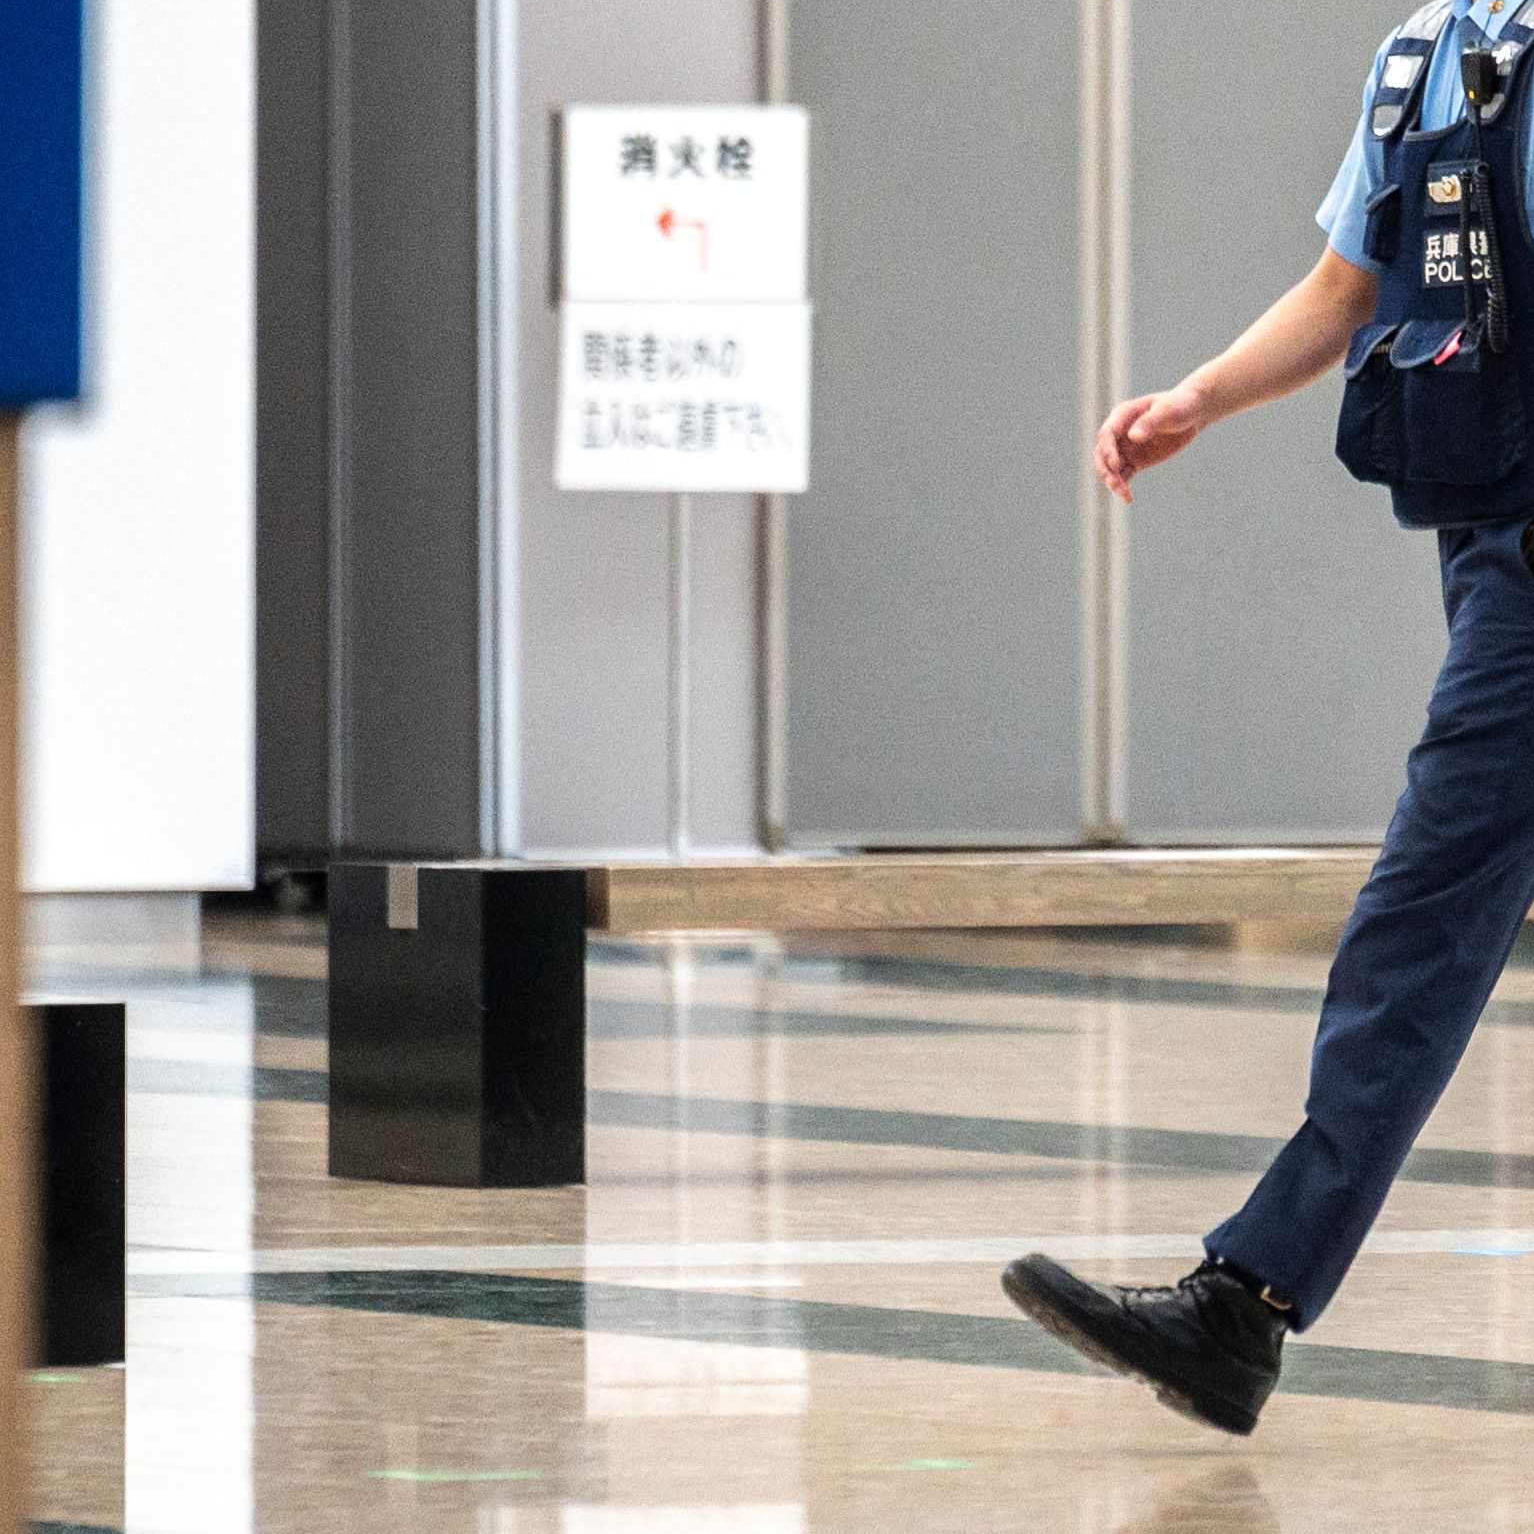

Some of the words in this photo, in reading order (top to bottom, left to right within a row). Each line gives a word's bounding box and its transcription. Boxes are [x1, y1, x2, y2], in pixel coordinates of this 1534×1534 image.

[619, 133, 754, 179] 消火栓
[1424, 259, 1494, 284] POLCE
